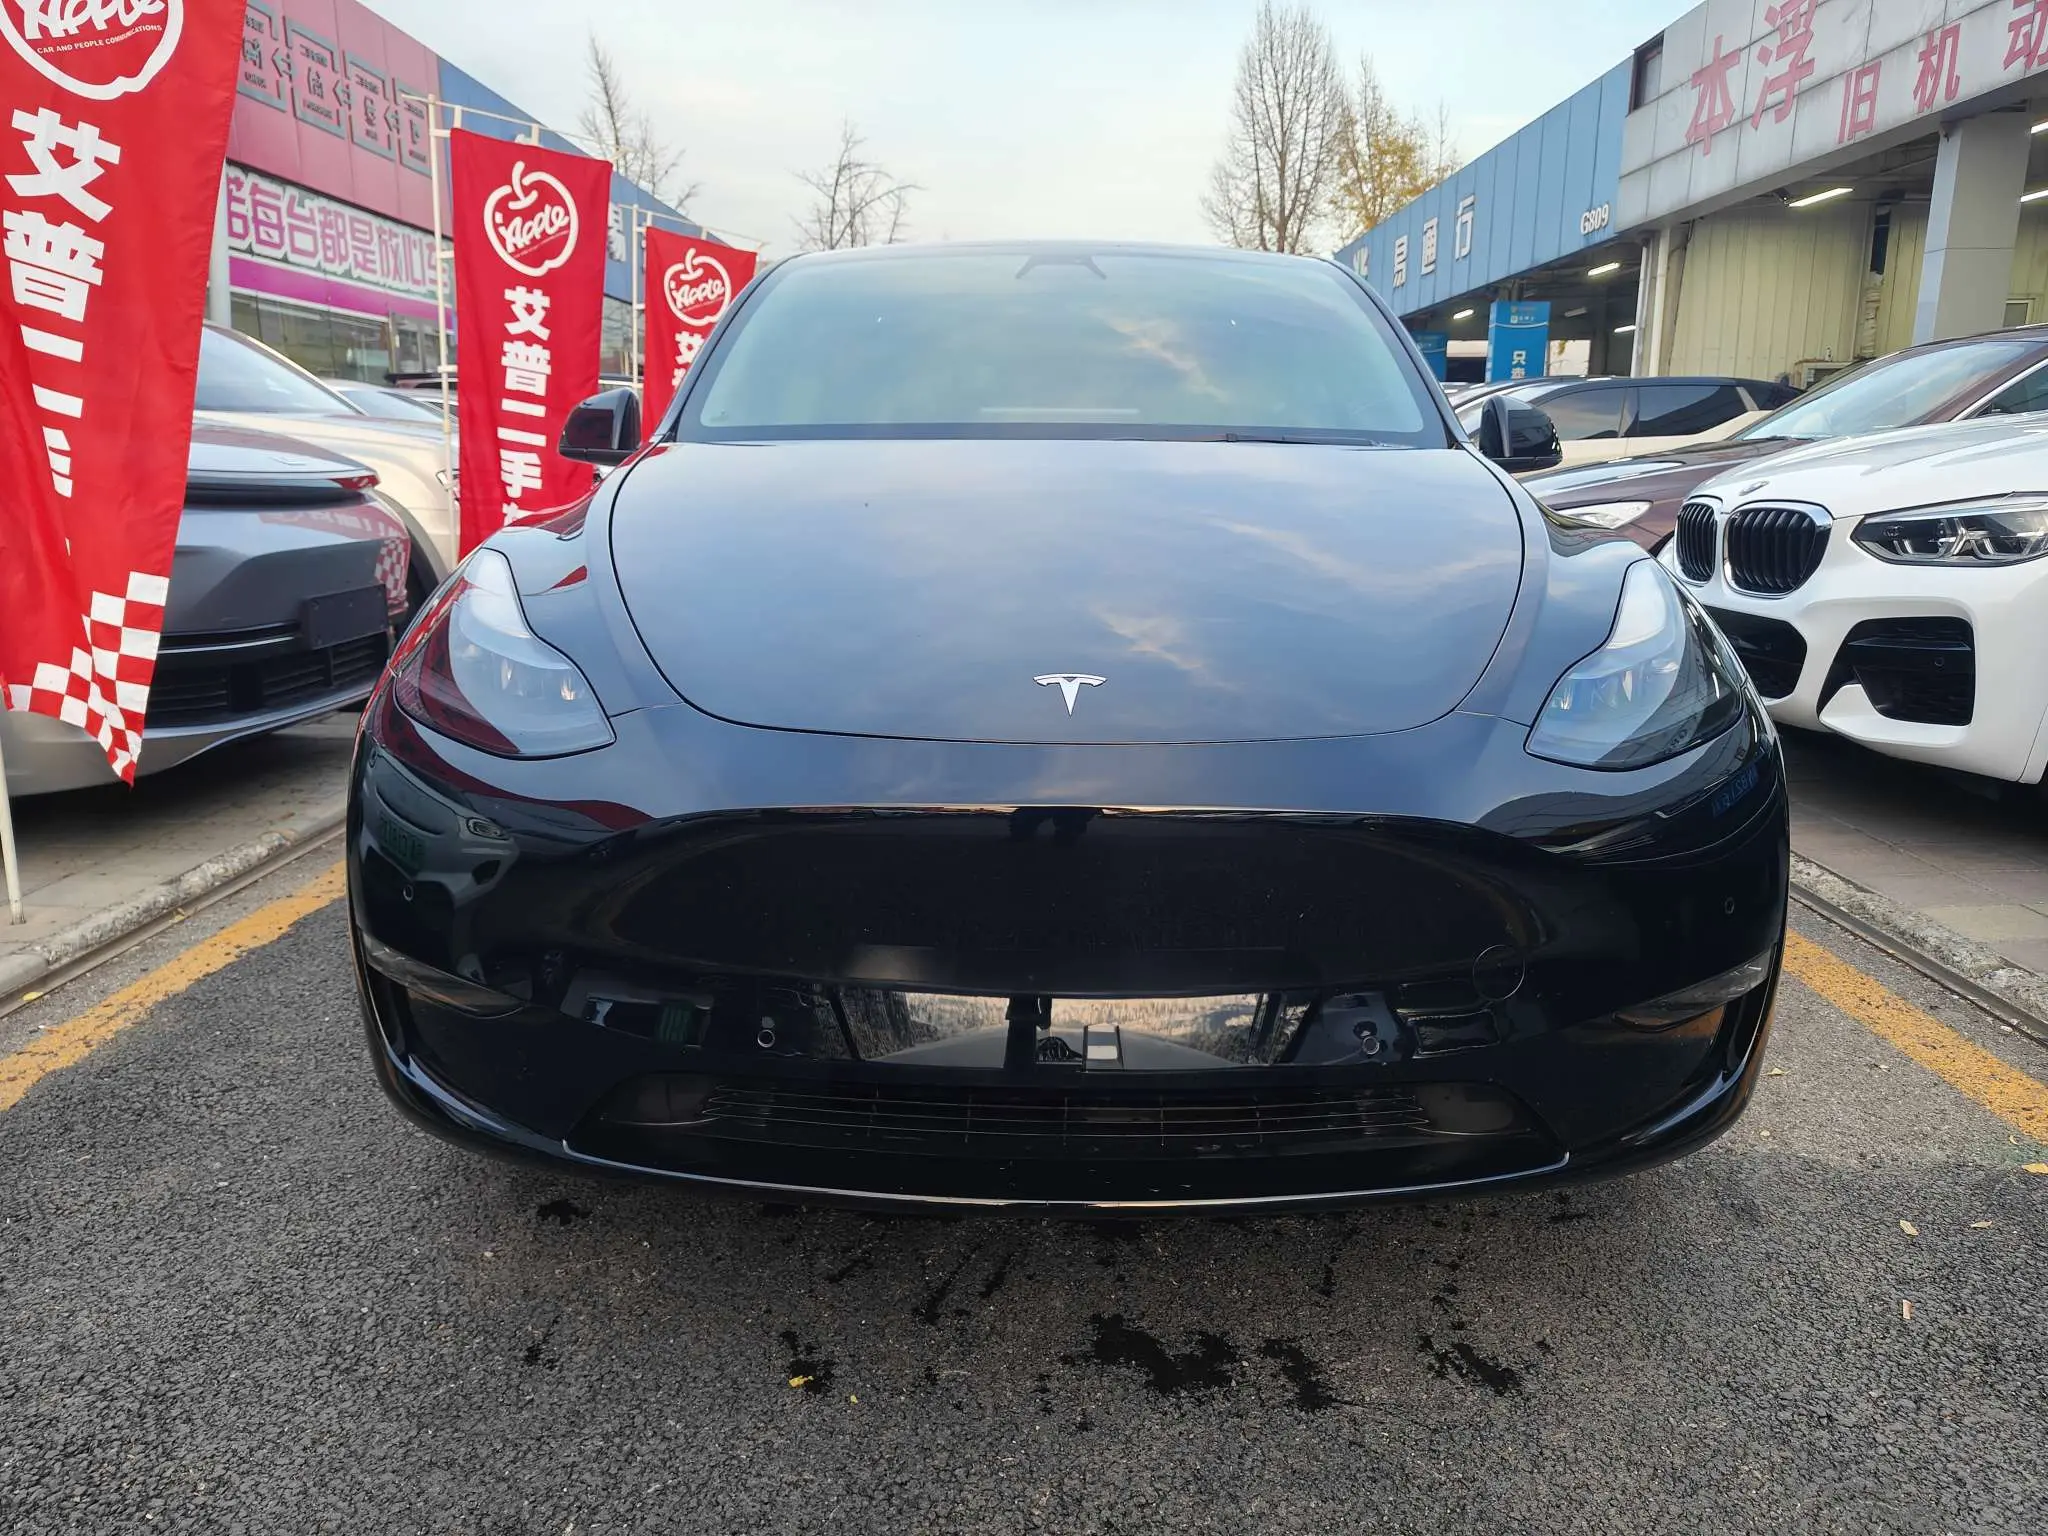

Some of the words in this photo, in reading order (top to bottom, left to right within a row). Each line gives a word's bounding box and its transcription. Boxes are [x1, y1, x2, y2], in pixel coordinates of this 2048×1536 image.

[37, 46, 54, 54] CAR
[56, 44, 73, 53] AND
[74, 39, 104, 49] PEOPLE
[1580, 203, 1610, 234] G809
